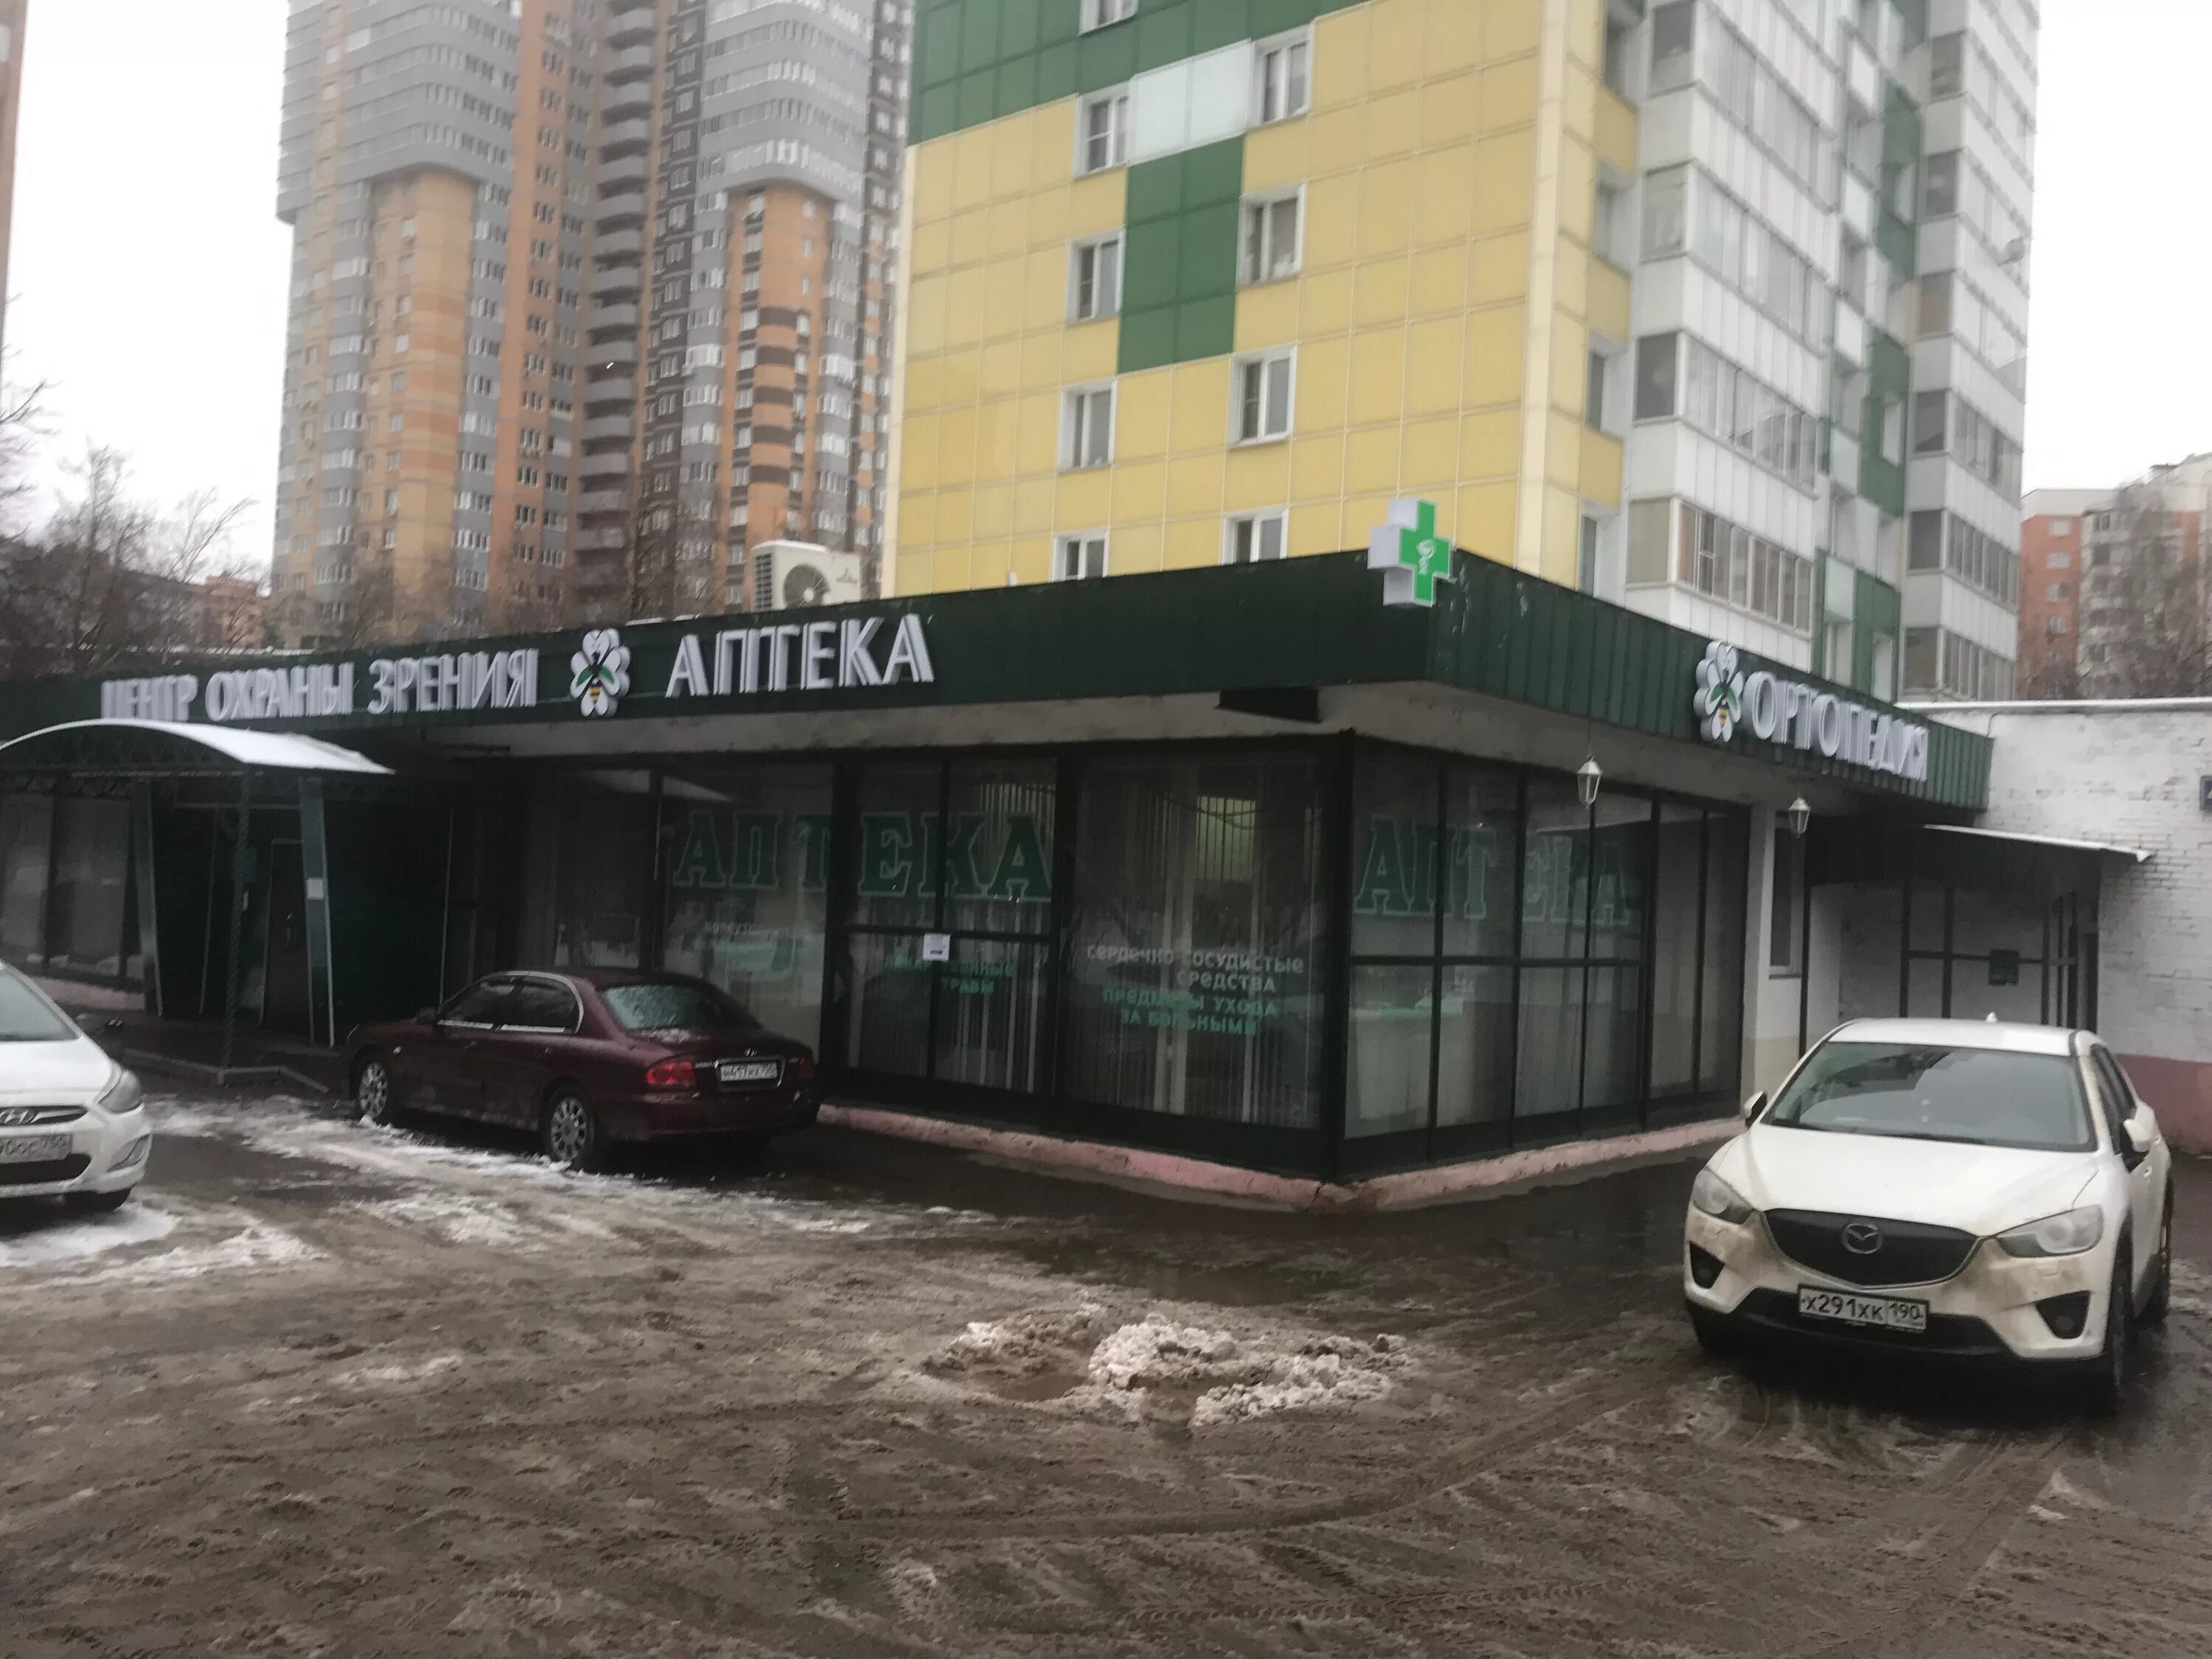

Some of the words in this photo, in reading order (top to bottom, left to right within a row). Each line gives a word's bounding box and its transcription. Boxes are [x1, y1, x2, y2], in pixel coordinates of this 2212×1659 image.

[100, 673, 198, 722] ЦЕНТР
[205, 663, 355, 722] ОХРАНЫ
[369, 647, 539, 714] ЗРЕНИЯ
[666, 613, 935, 698] АПТЕКА
[1742, 670, 1930, 782] ОРТОПЕДИЯ
[672, 811, 1053, 902] АПТЕКА
